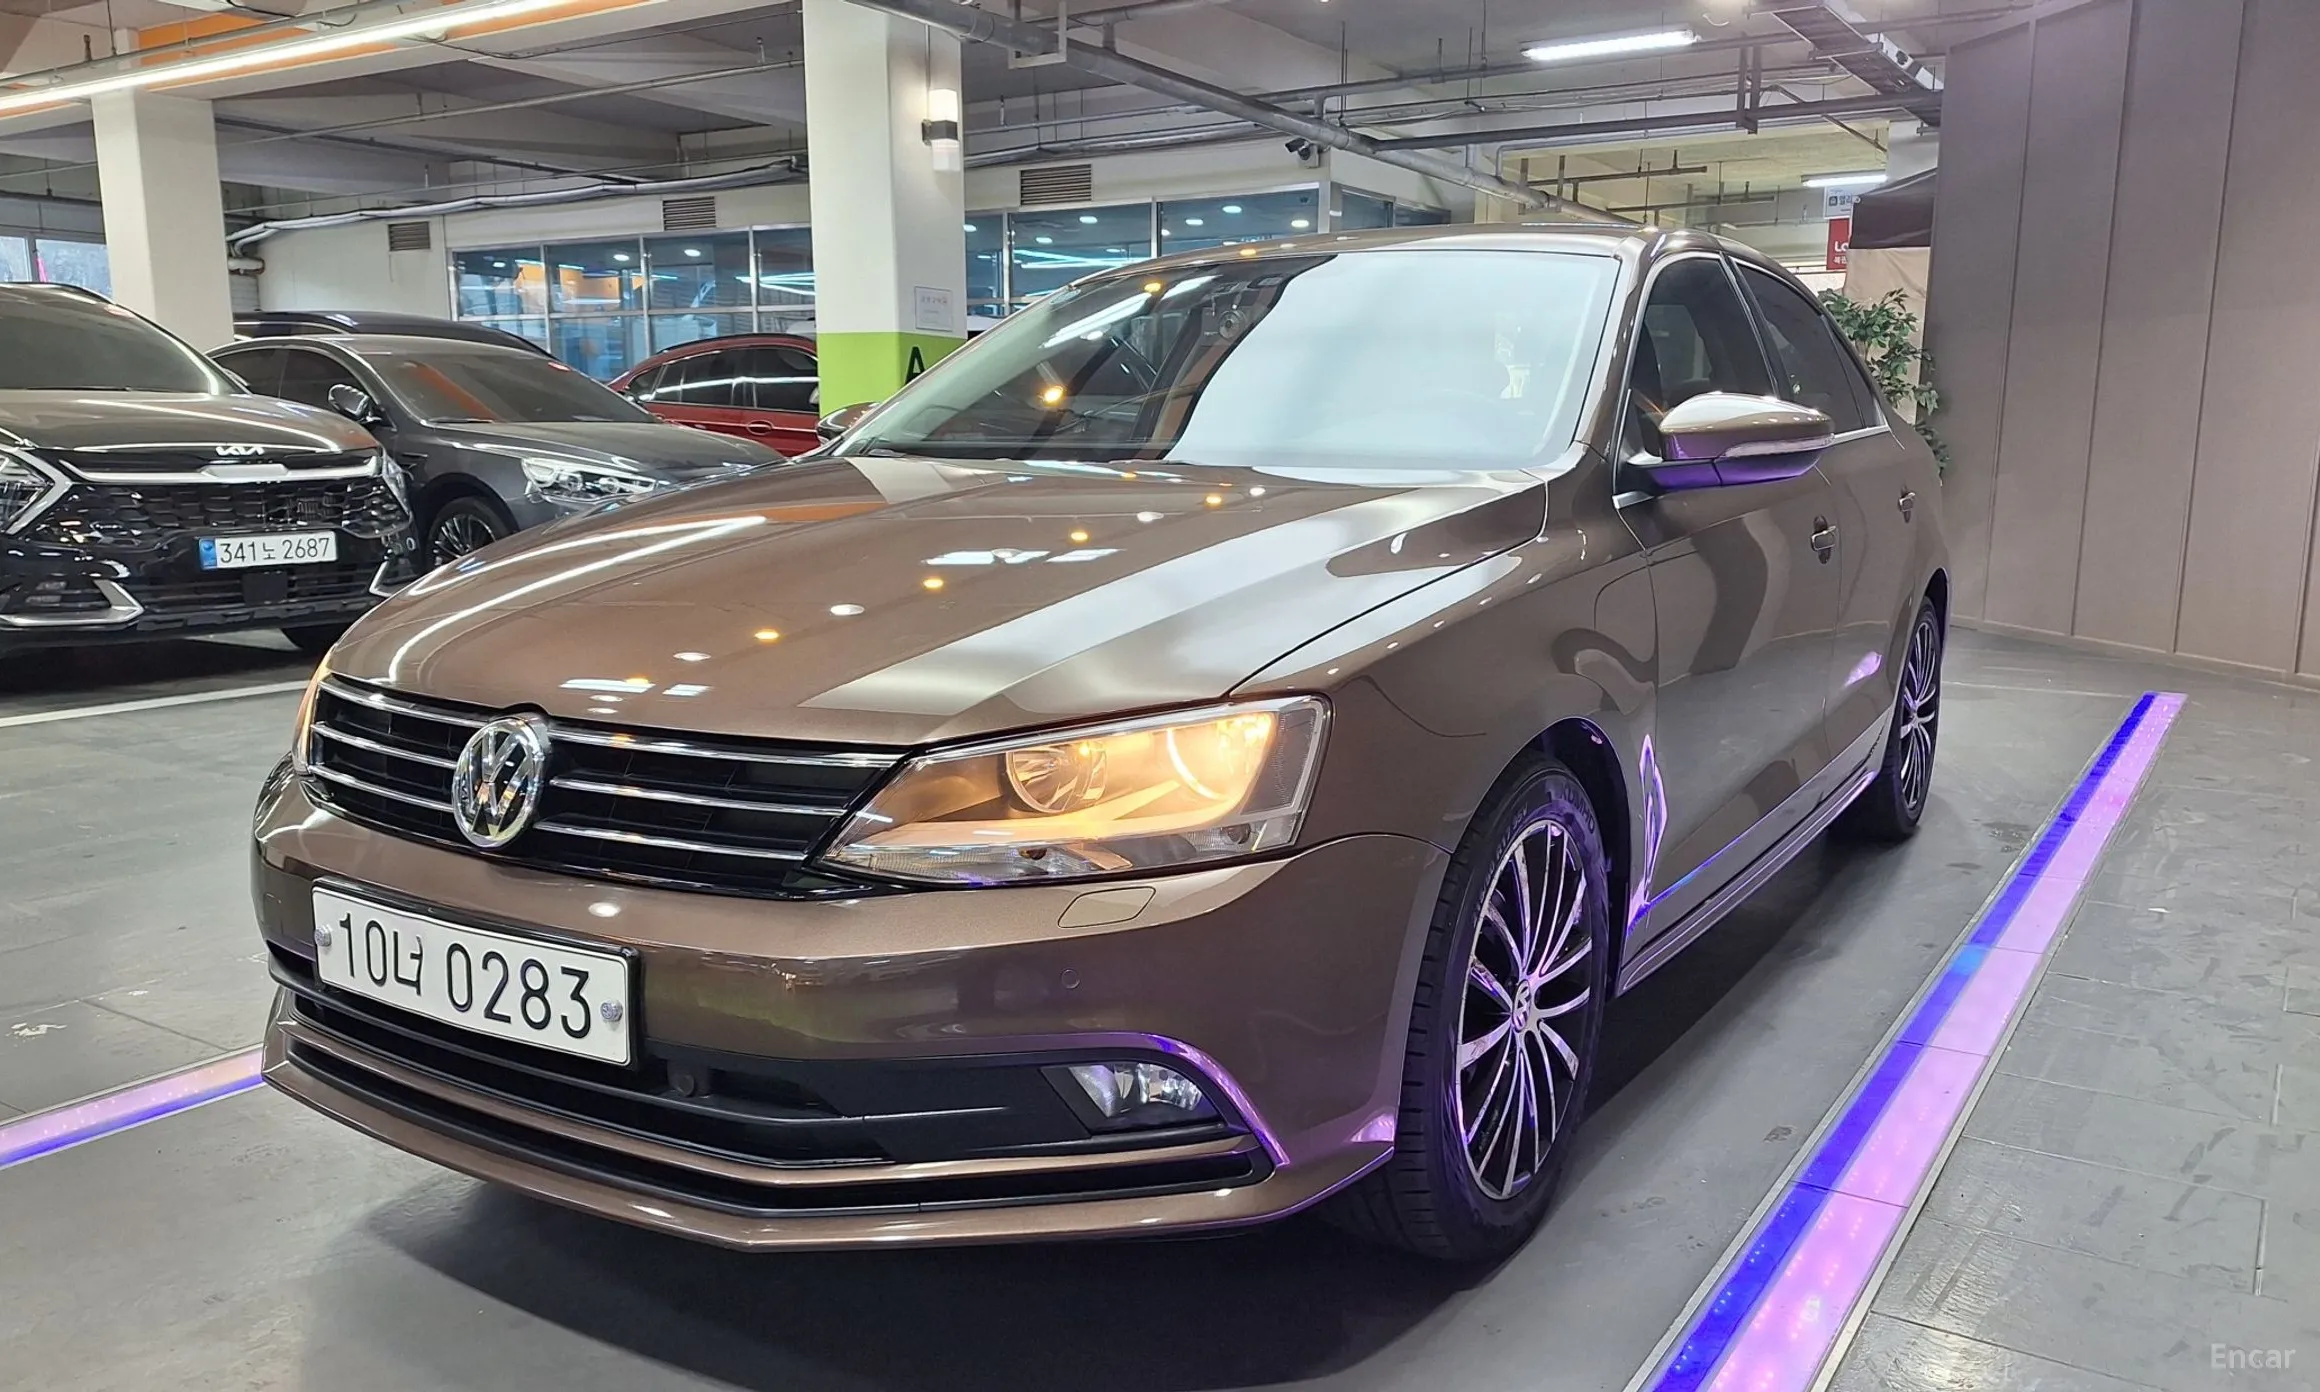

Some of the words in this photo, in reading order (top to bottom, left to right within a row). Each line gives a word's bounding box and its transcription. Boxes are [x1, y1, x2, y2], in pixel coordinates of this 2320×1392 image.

[220, 542, 276, 563] 341노
[282, 537, 330, 559] 2687
[339, 912, 423, 996] 10너
[446, 942, 591, 1039] 0283
